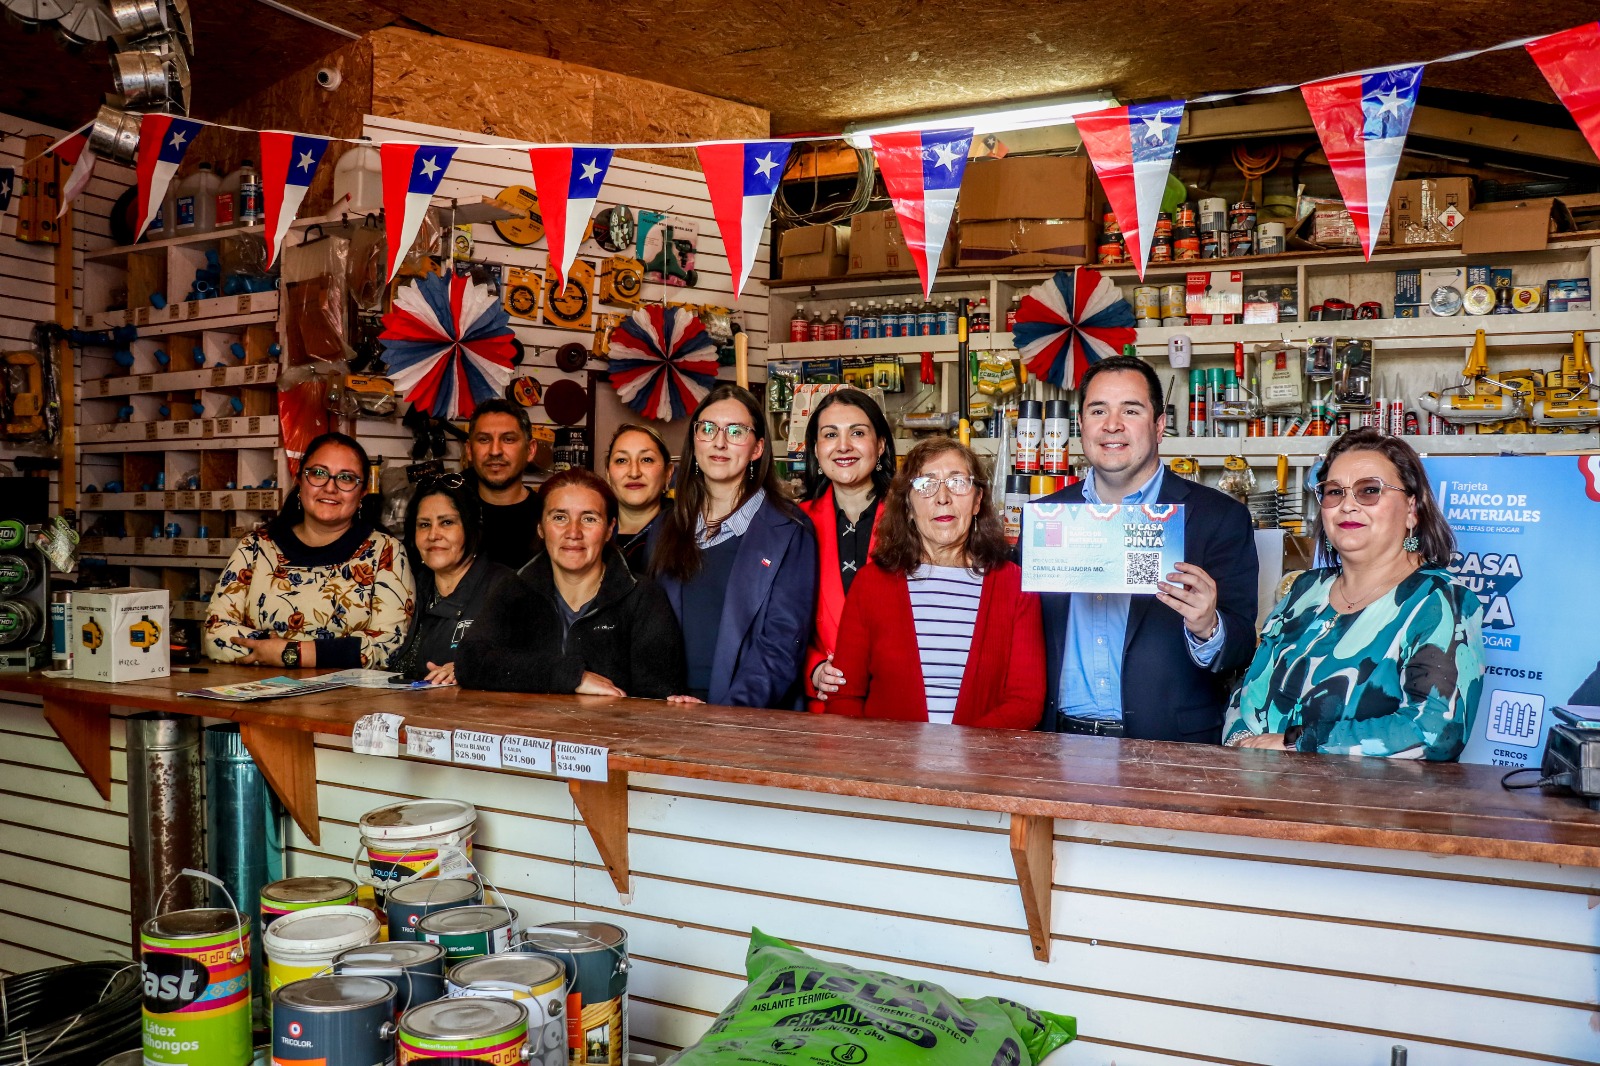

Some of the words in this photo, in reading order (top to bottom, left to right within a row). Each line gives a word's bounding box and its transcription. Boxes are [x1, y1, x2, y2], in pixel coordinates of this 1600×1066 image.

[1451, 481, 1488, 492] Tarjeta
[1450, 494, 1503, 507] BANCO
[1507, 495, 1527, 507] DE
[1448, 508, 1541, 523] MATERIALES
[1123, 523, 1136, 531] TU
[1137, 523, 1164, 531] CASA
[1124, 536, 1164, 547] PINTA
[1446, 552, 1522, 577] CASA
[1528, 670, 1543, 680] DE
[454, 731, 471, 741] FAST
[472, 732, 496, 744] LATEX
[503, 736, 521, 746] FAST
[522, 738, 551, 750] BARNIZ
[469, 743, 491, 752] BLANCO
[557, 743, 603, 756] TRICOSTAIN
[455, 750, 486, 762] $28.900
[503, 754, 536, 766] $21.800
[1493, 748, 1528, 761] CERCOS
[557, 762, 591, 773] $34.900
[1491, 758, 1498, 766] Y
[374, 868, 398, 878] COLORS
[756, 971, 979, 1038] AISLAN
[750, 998, 795, 1012] AISLANTE
[797, 992, 838, 1006] TÉRMICO
[917, 1014, 968, 1044] ACÚSTICO
[784, 1006, 925, 1042] GRANULADO
[145, 1018, 176, 1037] Látex
